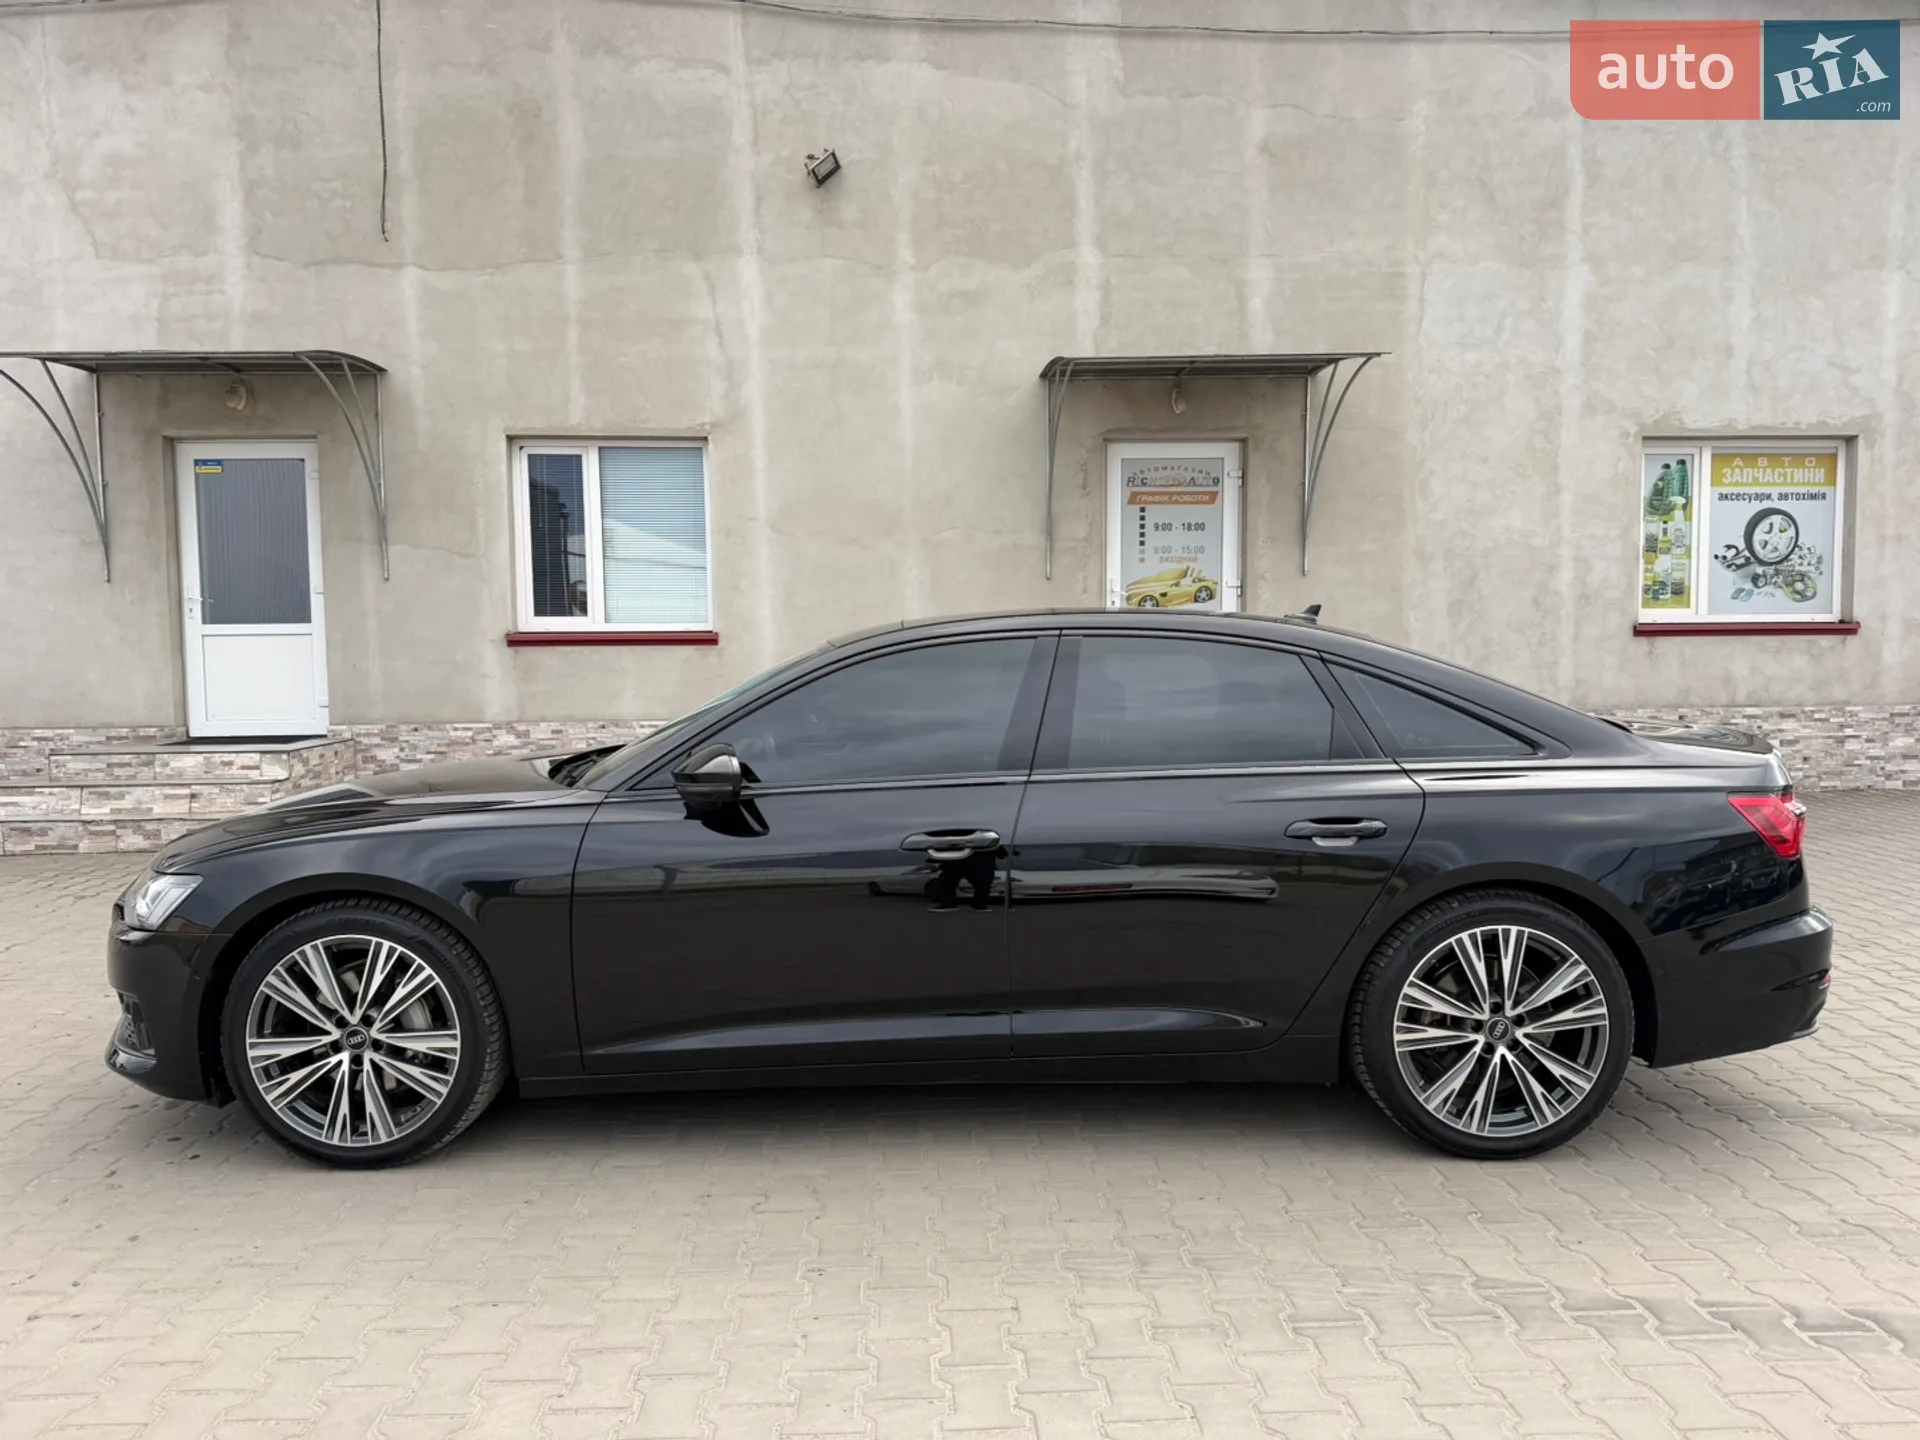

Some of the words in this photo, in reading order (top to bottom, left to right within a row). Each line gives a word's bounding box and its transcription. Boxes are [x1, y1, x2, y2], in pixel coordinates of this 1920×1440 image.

[1721, 468, 1826, 484] ЗАПЧАСТИНИ
[1717, 491, 1775, 503] аксесуари,
[1777, 490, 1827, 502] автохімія
[1153, 522, 1173, 532] 9:00
[1181, 522, 1206, 532] 18:00
